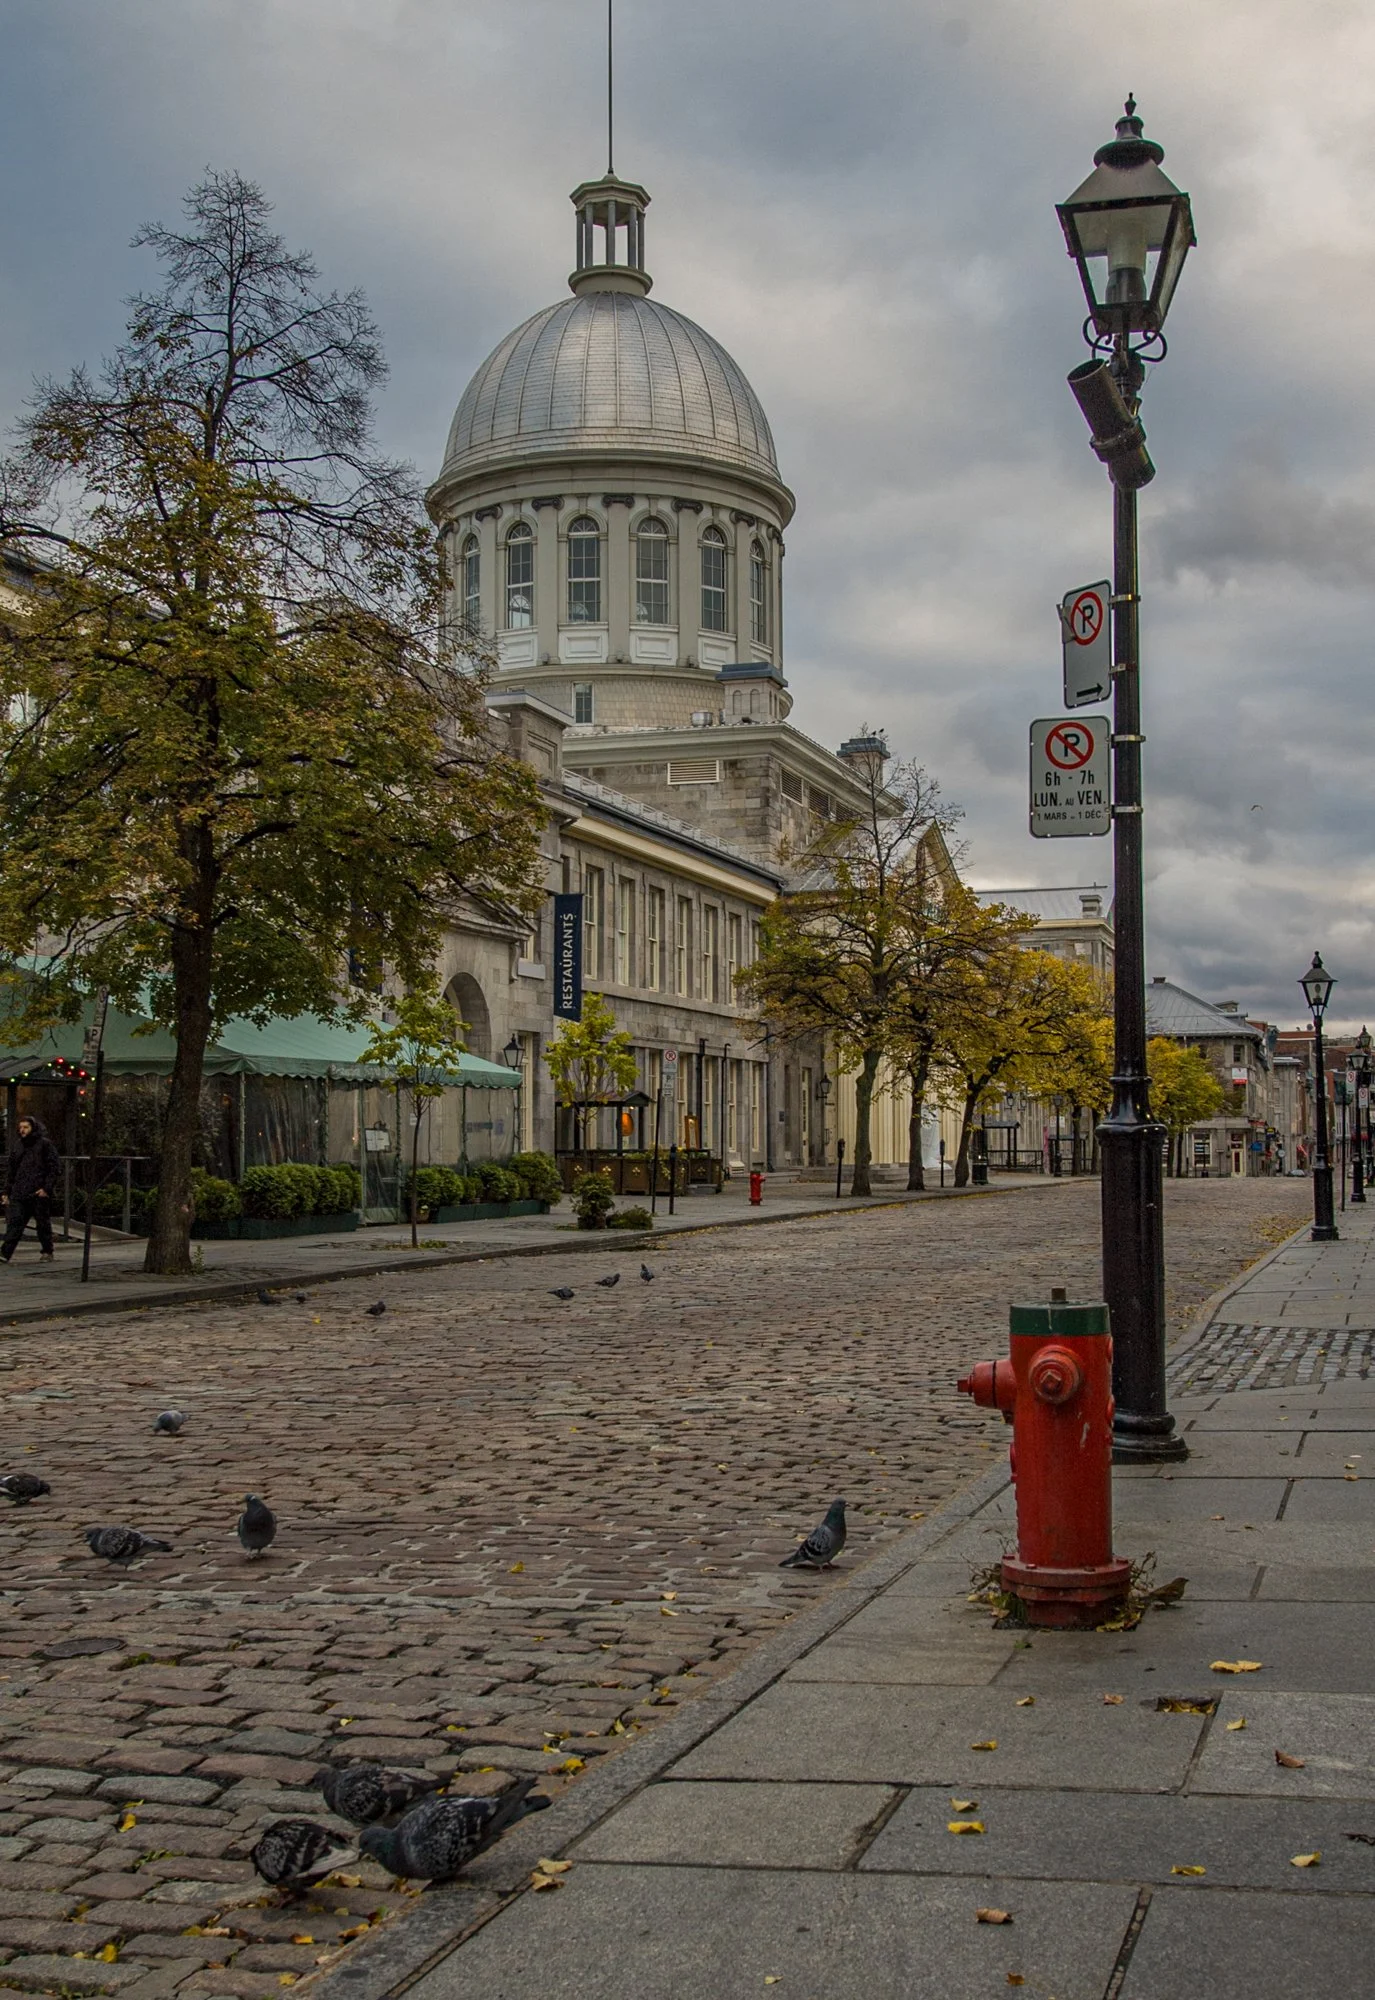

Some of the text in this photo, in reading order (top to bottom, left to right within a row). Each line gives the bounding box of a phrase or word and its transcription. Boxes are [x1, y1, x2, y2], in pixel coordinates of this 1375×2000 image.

[1045, 771, 1061, 787] 6h
[1080, 769, 1095, 785] 7h
[1034, 790, 1106, 807] LUN. AU VEN.
[1037, 813, 1041, 821] 1
[1044, 811, 1067, 821] MARS
[1078, 811, 1082, 819] 1
[1085, 809, 1104, 819] DÉC.
[562, 912, 574, 1010] RESTAURANTS
